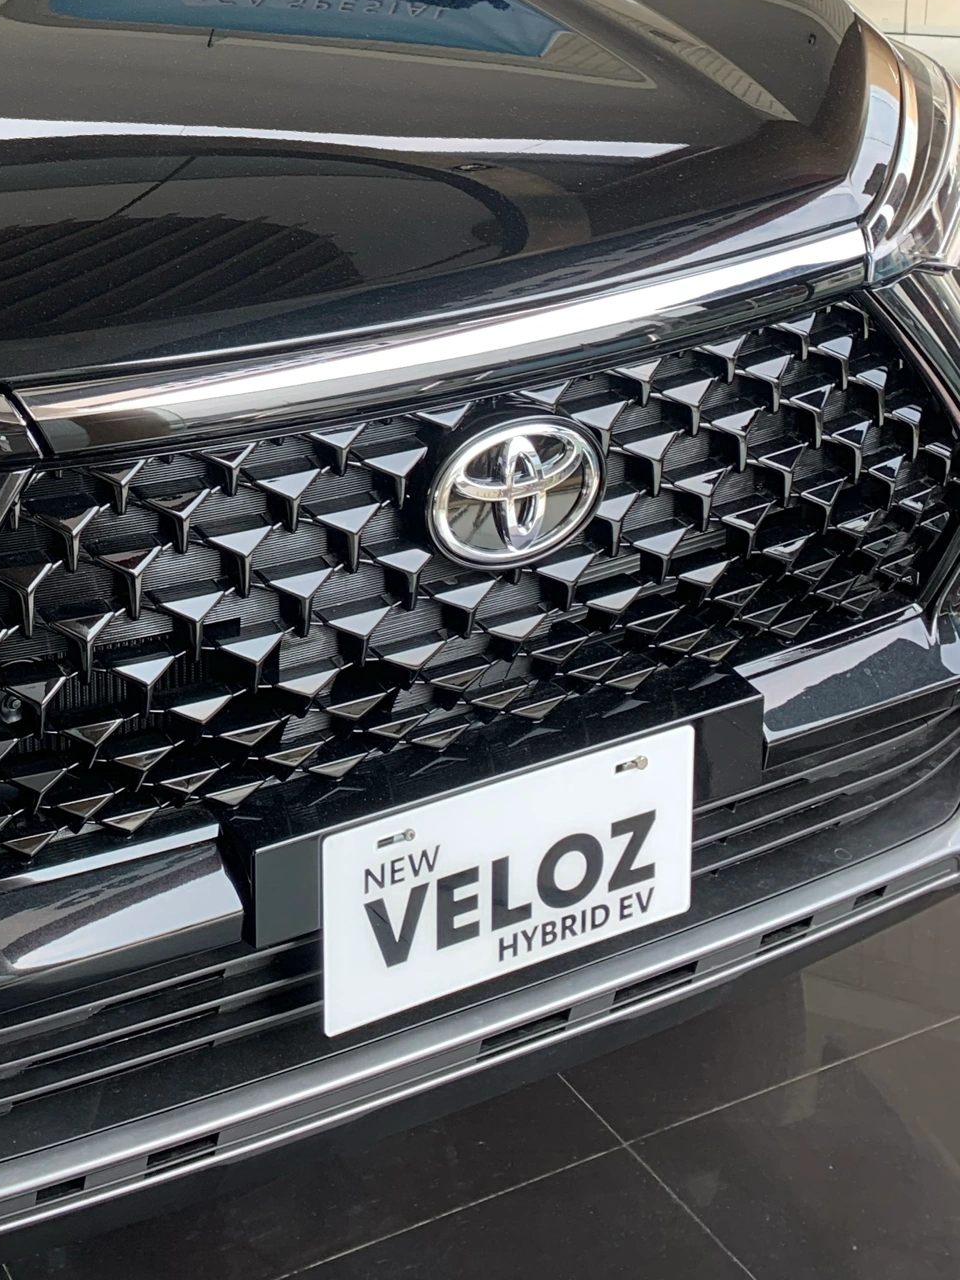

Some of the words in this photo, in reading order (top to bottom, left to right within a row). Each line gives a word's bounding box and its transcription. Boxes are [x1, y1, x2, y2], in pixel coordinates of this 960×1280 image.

[363, 843, 441, 894] NEW
[363, 808, 657, 969] VELOZ
[498, 903, 611, 963] HYBRID
[619, 886, 656, 922] EV
